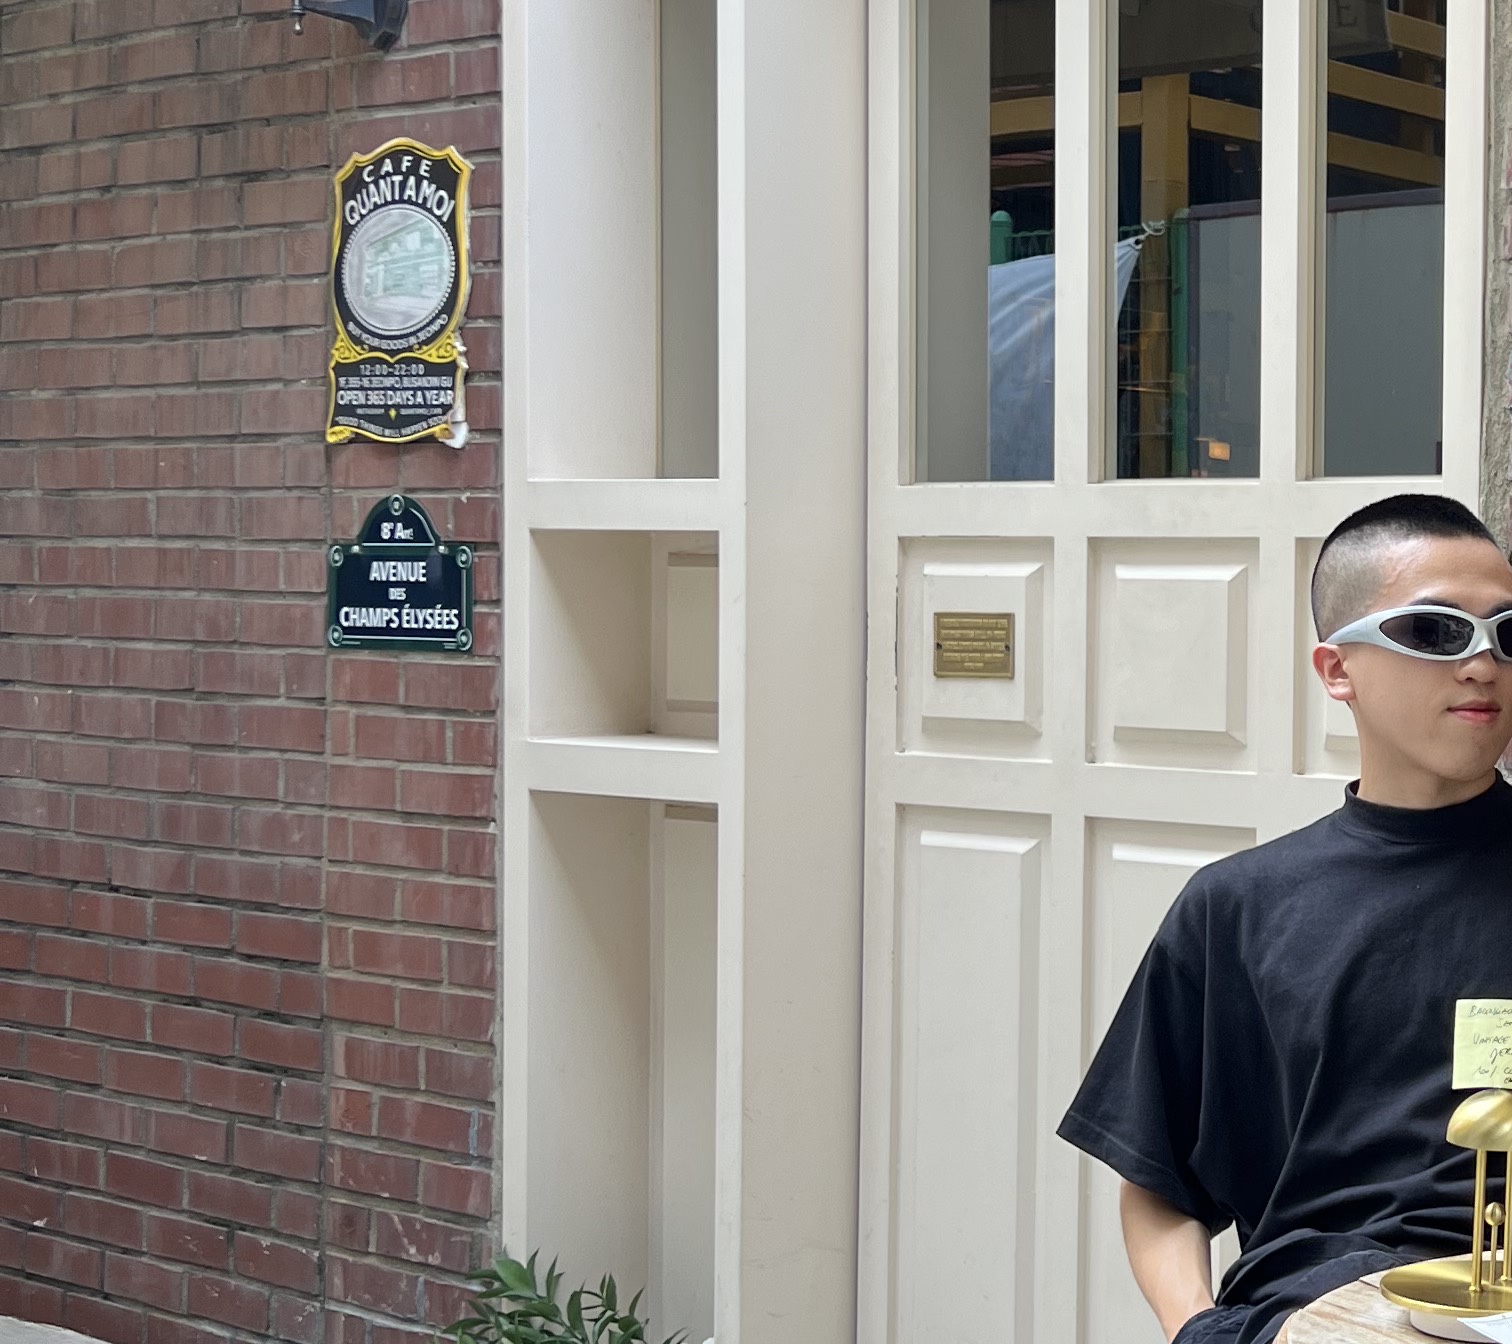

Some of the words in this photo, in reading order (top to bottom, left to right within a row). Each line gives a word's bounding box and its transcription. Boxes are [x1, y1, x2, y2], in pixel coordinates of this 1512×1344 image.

[362, 155, 433, 183] CAFE
[336, 390, 366, 406] OPEN
[367, 390, 386, 405] 365
[386, 390, 415, 406] DAYS
[415, 390, 424, 405] A
[424, 390, 454, 406] YEAR
[369, 561, 427, 582] AVENUE
[388, 587, 406, 600] DES
[339, 606, 400, 629] CHAMPS
[401, 603, 459, 630] ÉLYSÉES
